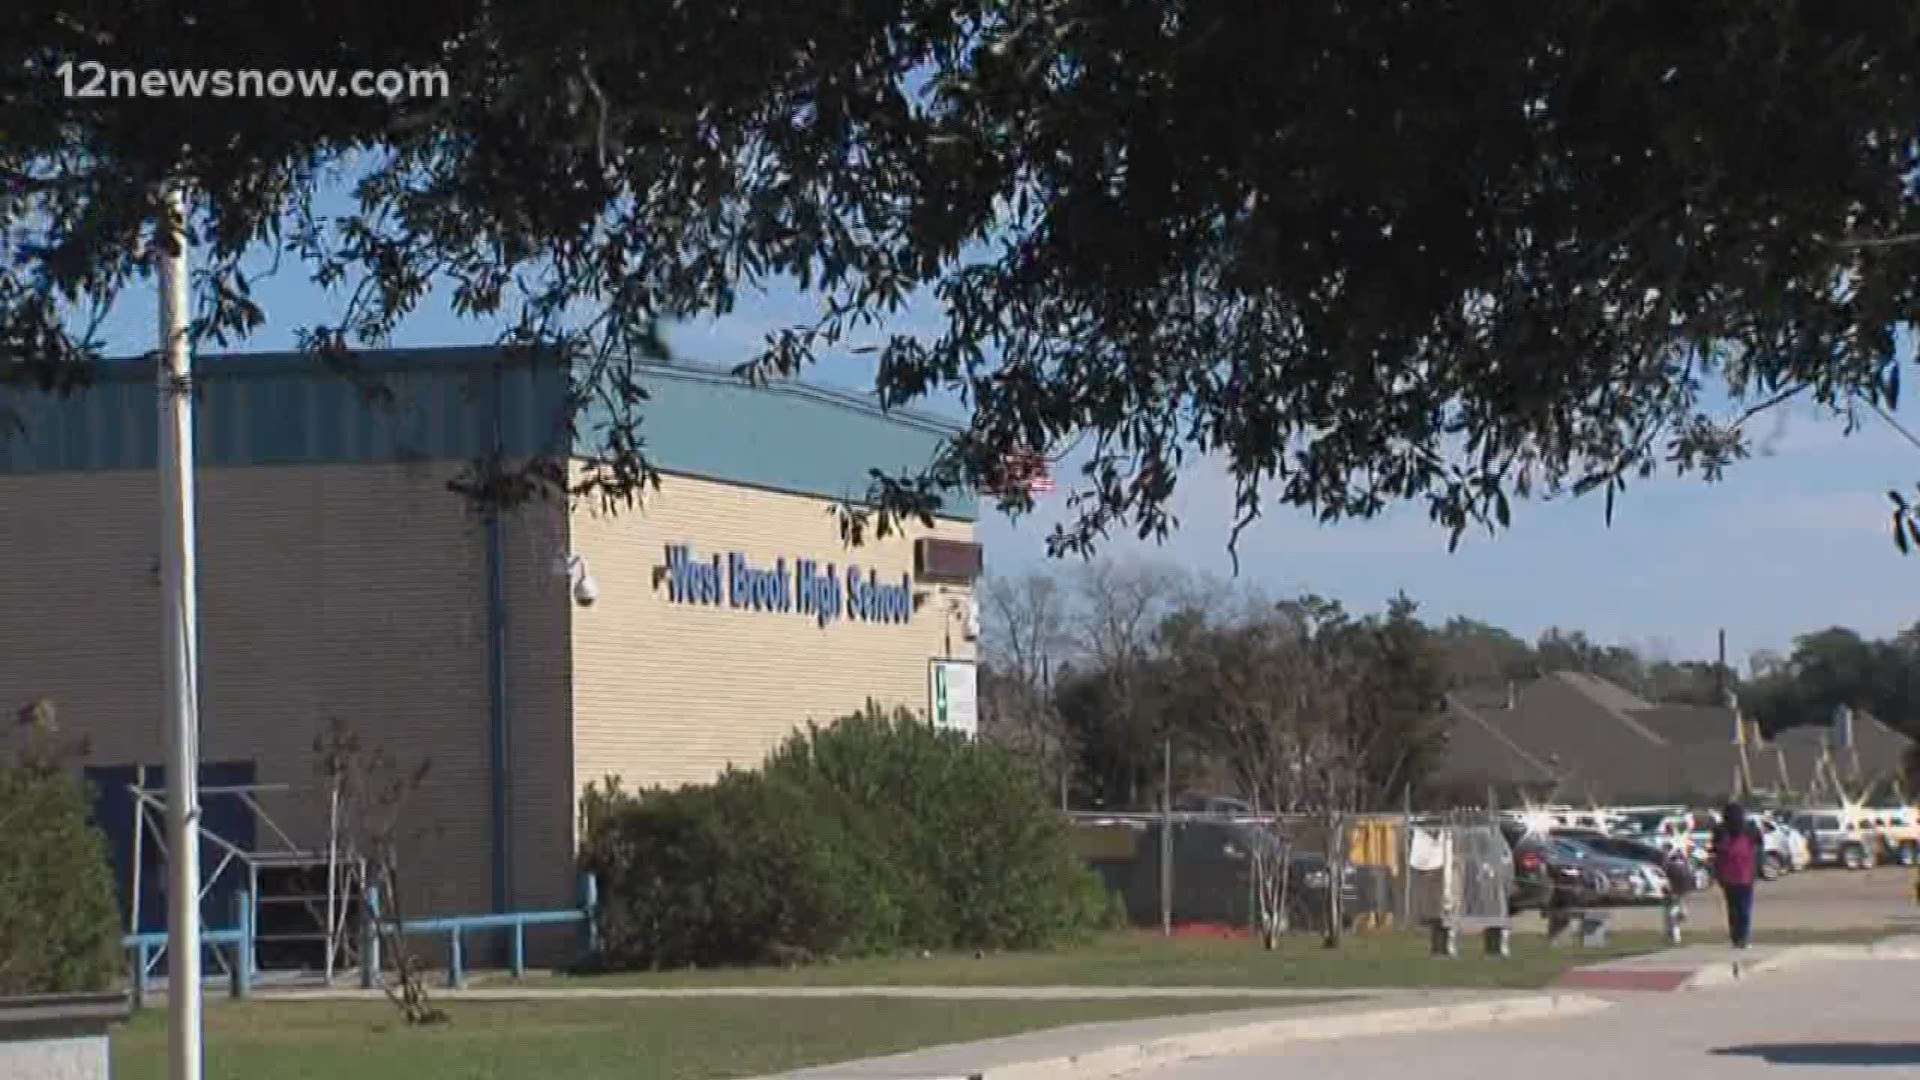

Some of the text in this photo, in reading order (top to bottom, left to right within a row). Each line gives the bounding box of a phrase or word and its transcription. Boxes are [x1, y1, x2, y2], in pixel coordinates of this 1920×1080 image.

[665, 543, 912, 629] West Brook High School
